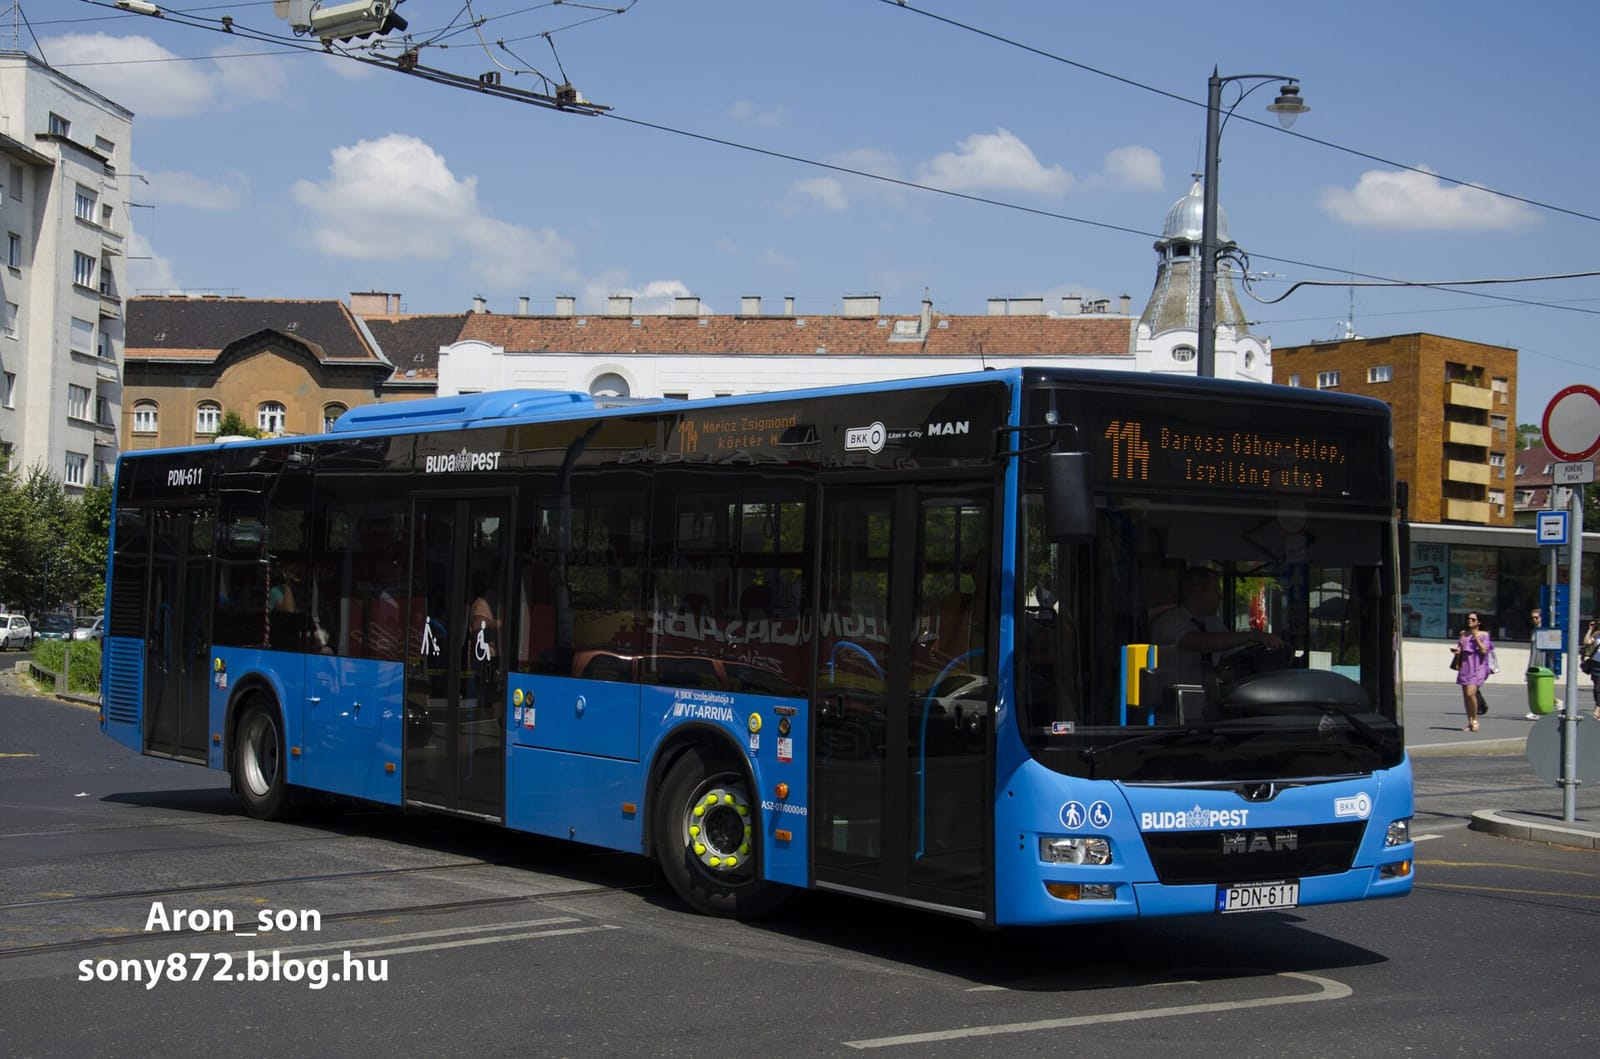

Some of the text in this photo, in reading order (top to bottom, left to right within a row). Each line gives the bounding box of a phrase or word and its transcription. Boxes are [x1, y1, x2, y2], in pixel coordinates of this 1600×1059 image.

[741, 414, 796, 432] Zsigmond
[927, 420, 970, 436] MAN
[678, 420, 698, 453] 114
[850, 434, 868, 444] BKK
[908, 430, 924, 438] City
[1103, 421, 1150, 480] 114
[1160, 427, 1346, 464] Baross Gábor-telep,
[167, 467, 203, 487] PDN-611
[1185, 458, 1324, 488] Ispiláng utca
[674, 690, 680, 699] A
[680, 691, 692, 700] BKK
[684, 704, 734, 721] VT-ARRIVA
[1223, 829, 1298, 854] MAN
[1229, 886, 1294, 908] PDN-611
